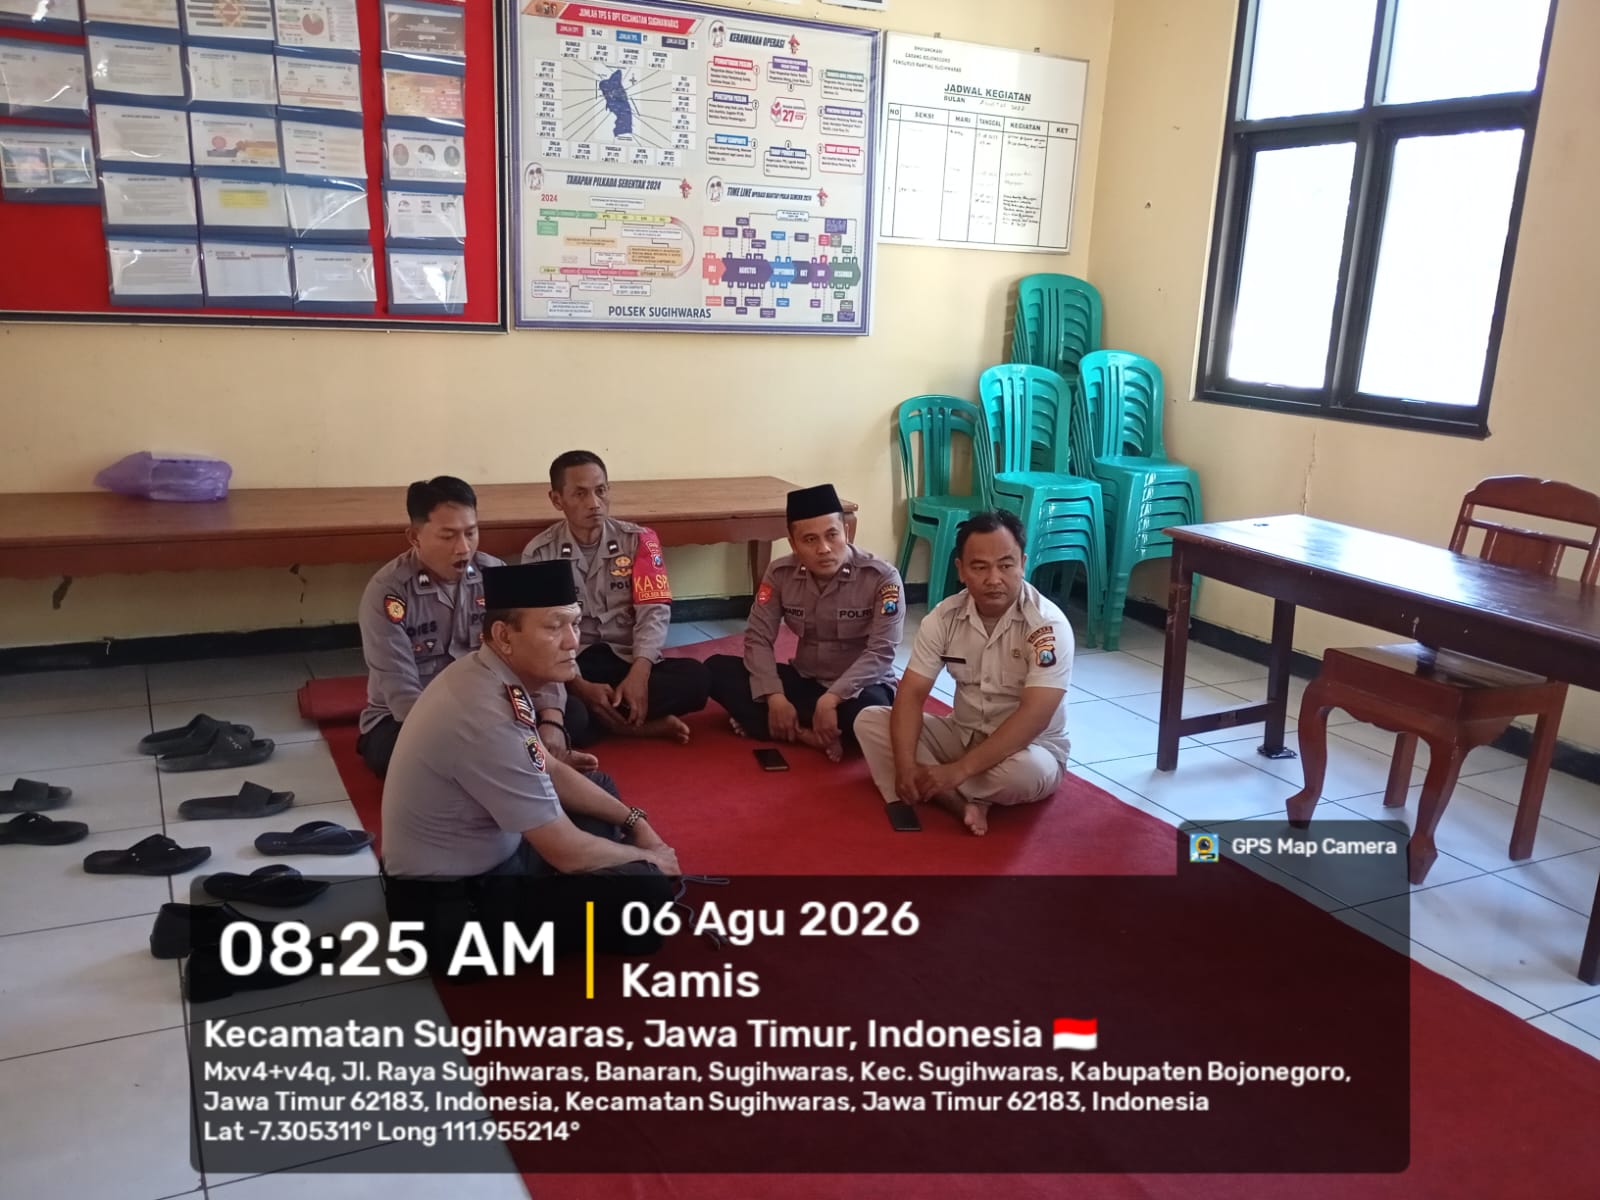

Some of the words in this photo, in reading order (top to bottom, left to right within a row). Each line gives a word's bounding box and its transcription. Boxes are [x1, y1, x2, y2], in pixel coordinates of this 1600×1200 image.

[729, 33, 762, 46] KERAWANAN
[762, 37, 786, 49] OPERASI
[944, 83, 982, 96] JADWAL
[985, 87, 1032, 102] KEGIATAN
[943, 95, 966, 104] BULAN
[782, 110, 794, 122] 27
[914, 111, 935, 119] SEKSI
[955, 115, 971, 124] HARI
[979, 117, 1001, 127] TANGGAL
[1010, 122, 1041, 132] KEGIATAN
[566, 174, 593, 187] TAHAPAN
[593, 176, 617, 188] PILKADA
[617, 178, 646, 190] SERENTAK
[646, 180, 661, 191] 2024
[541, 193, 558, 202] 2024
[727, 186, 740, 197] TIME
[740, 187, 752, 198] LINE
[608, 305, 646, 317] POLSEK
[649, 306, 712, 319] SUGIHWARAS
[633, 575, 654, 593] KA
